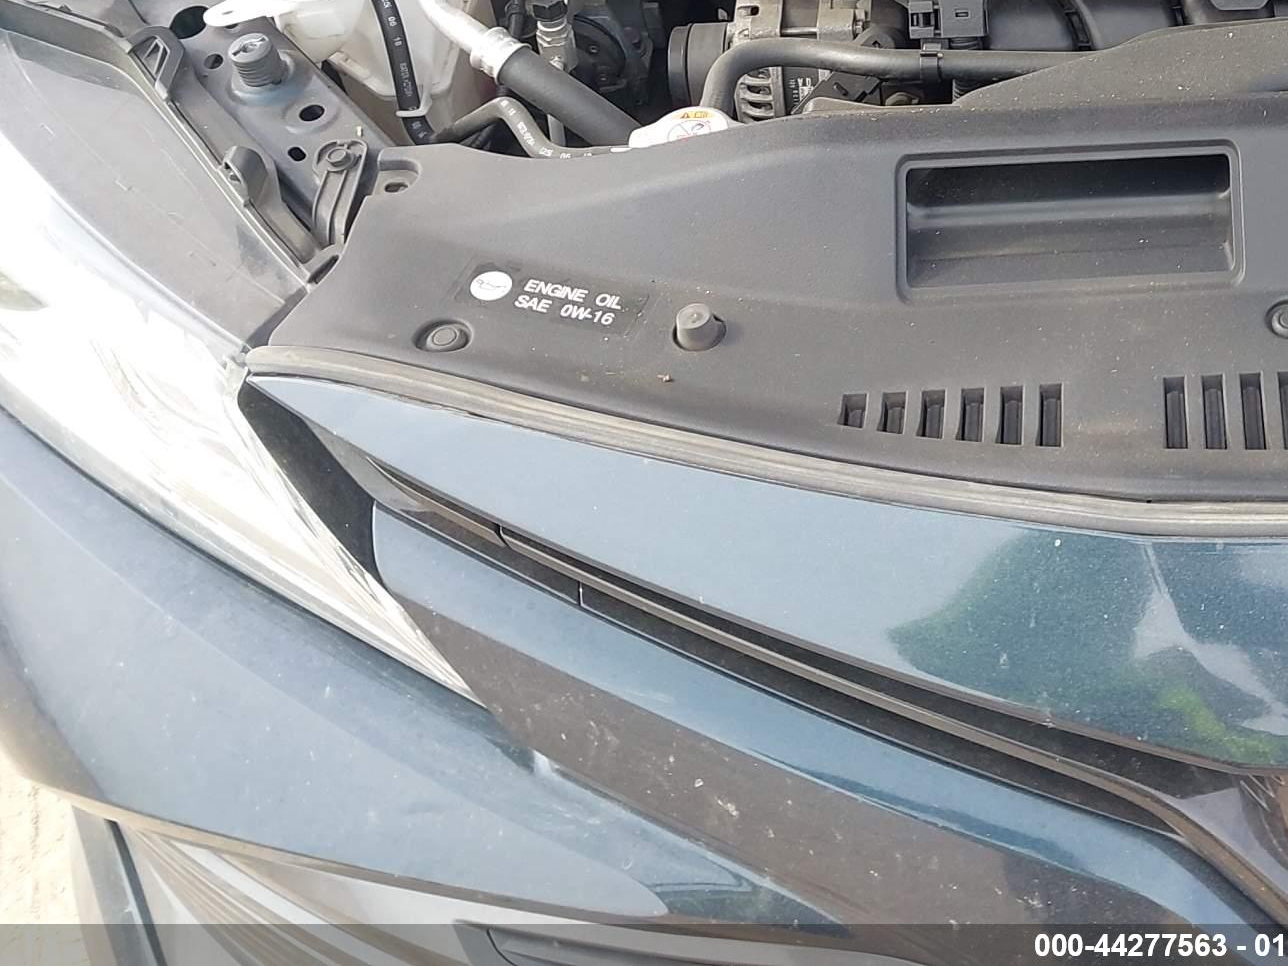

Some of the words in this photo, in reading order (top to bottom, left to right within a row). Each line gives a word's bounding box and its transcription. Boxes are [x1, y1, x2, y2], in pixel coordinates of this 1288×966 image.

[523, 279, 589, 302] ENGINE
[595, 292, 623, 310] OIL
[514, 295, 553, 313] SAE
[560, 304, 615, 326] 0W-16
